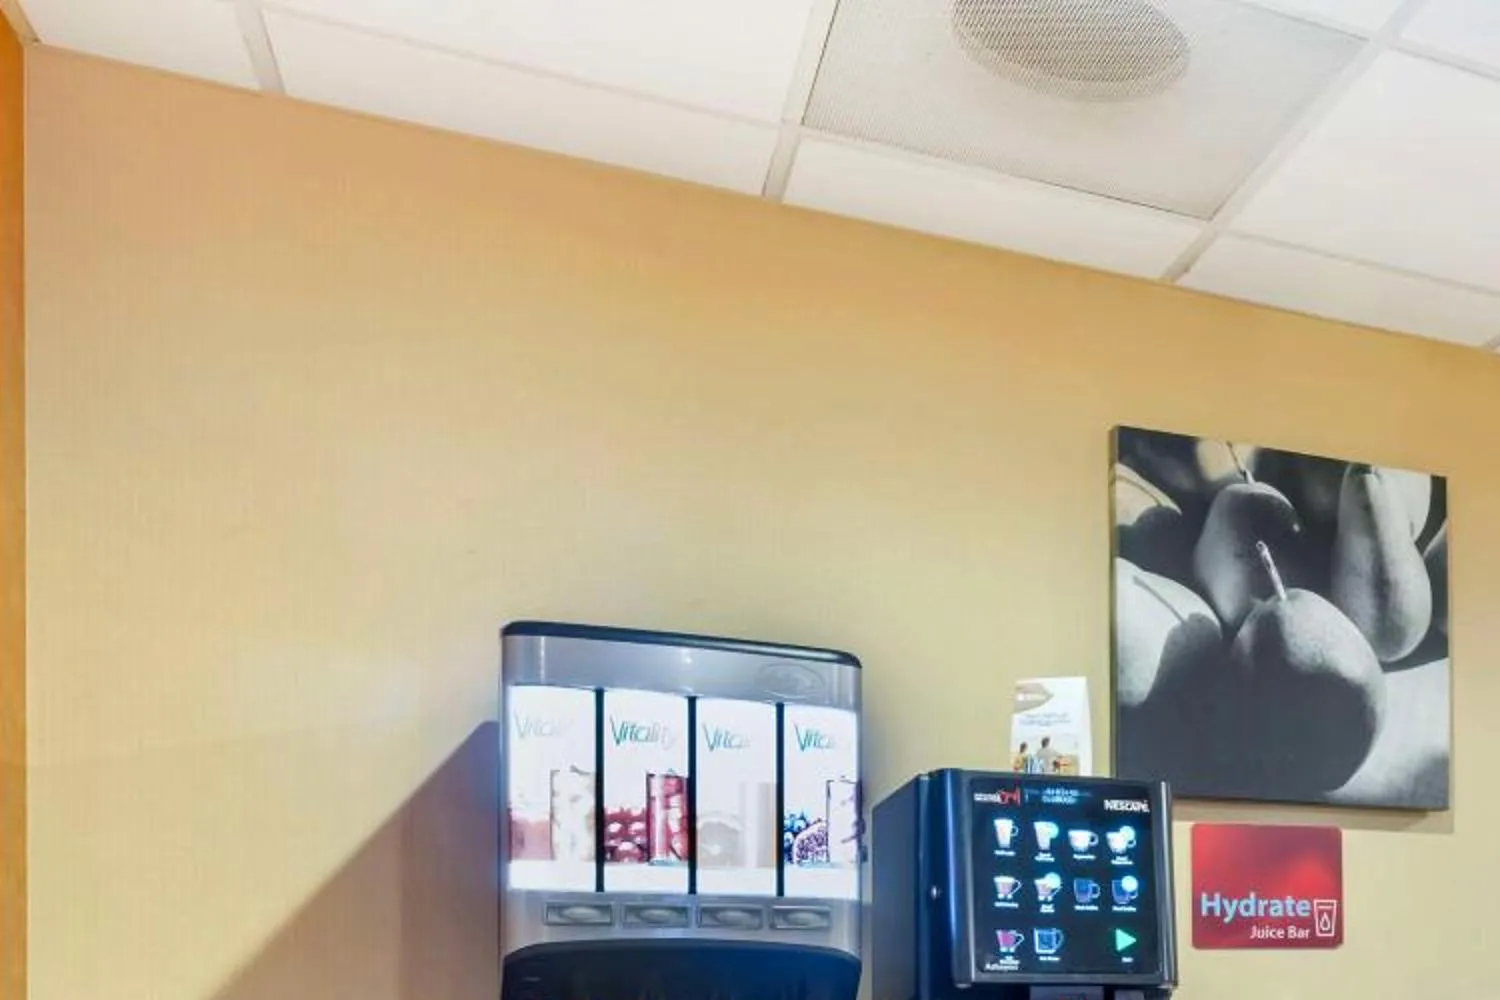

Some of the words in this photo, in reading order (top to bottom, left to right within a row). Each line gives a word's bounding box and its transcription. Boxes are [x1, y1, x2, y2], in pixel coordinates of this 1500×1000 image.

[1201, 892, 1311, 924] Hydrate
[1250, 925, 1285, 939] Juice
[1287, 925, 1310, 939] Bar
